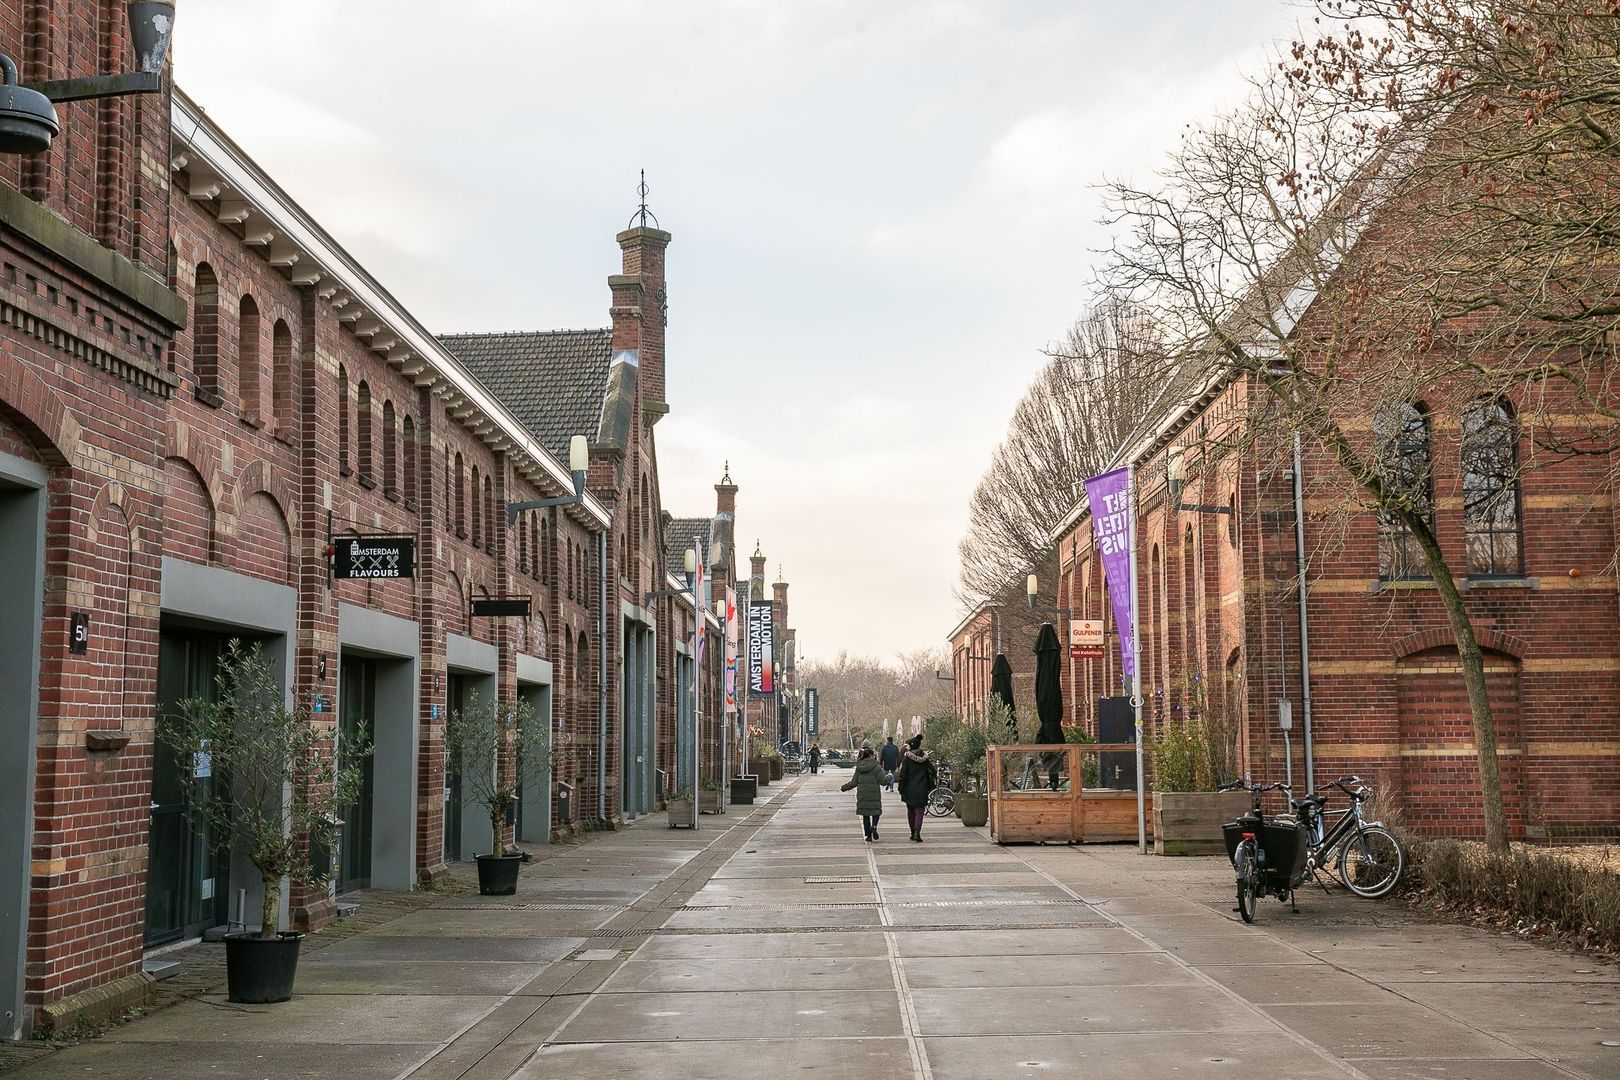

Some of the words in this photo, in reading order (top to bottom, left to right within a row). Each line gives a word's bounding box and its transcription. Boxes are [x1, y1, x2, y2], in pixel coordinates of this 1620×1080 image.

[350, 569, 399, 577] FLAVOURS
[750, 606, 761, 618] IN
[75, 624, 84, 642] 5
[760, 606, 772, 646] MOTION
[750, 620, 762, 692] AMSTERDAM
